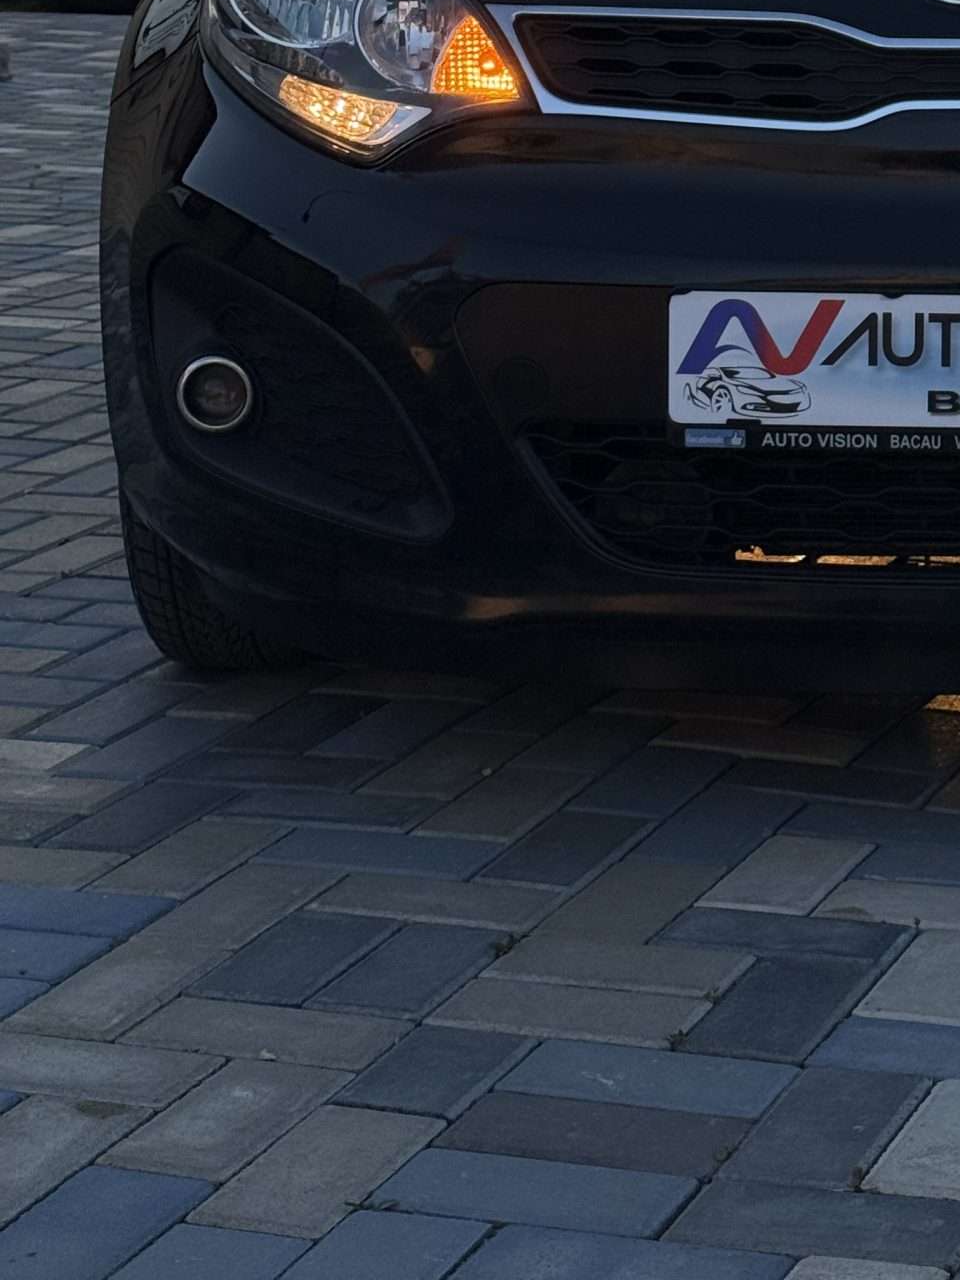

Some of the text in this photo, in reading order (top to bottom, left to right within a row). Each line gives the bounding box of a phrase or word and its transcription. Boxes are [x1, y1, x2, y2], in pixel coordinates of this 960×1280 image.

[762, 432, 812, 448] AUTO
[819, 433, 877, 449] VISION
[890, 434, 941, 450] BACAU
